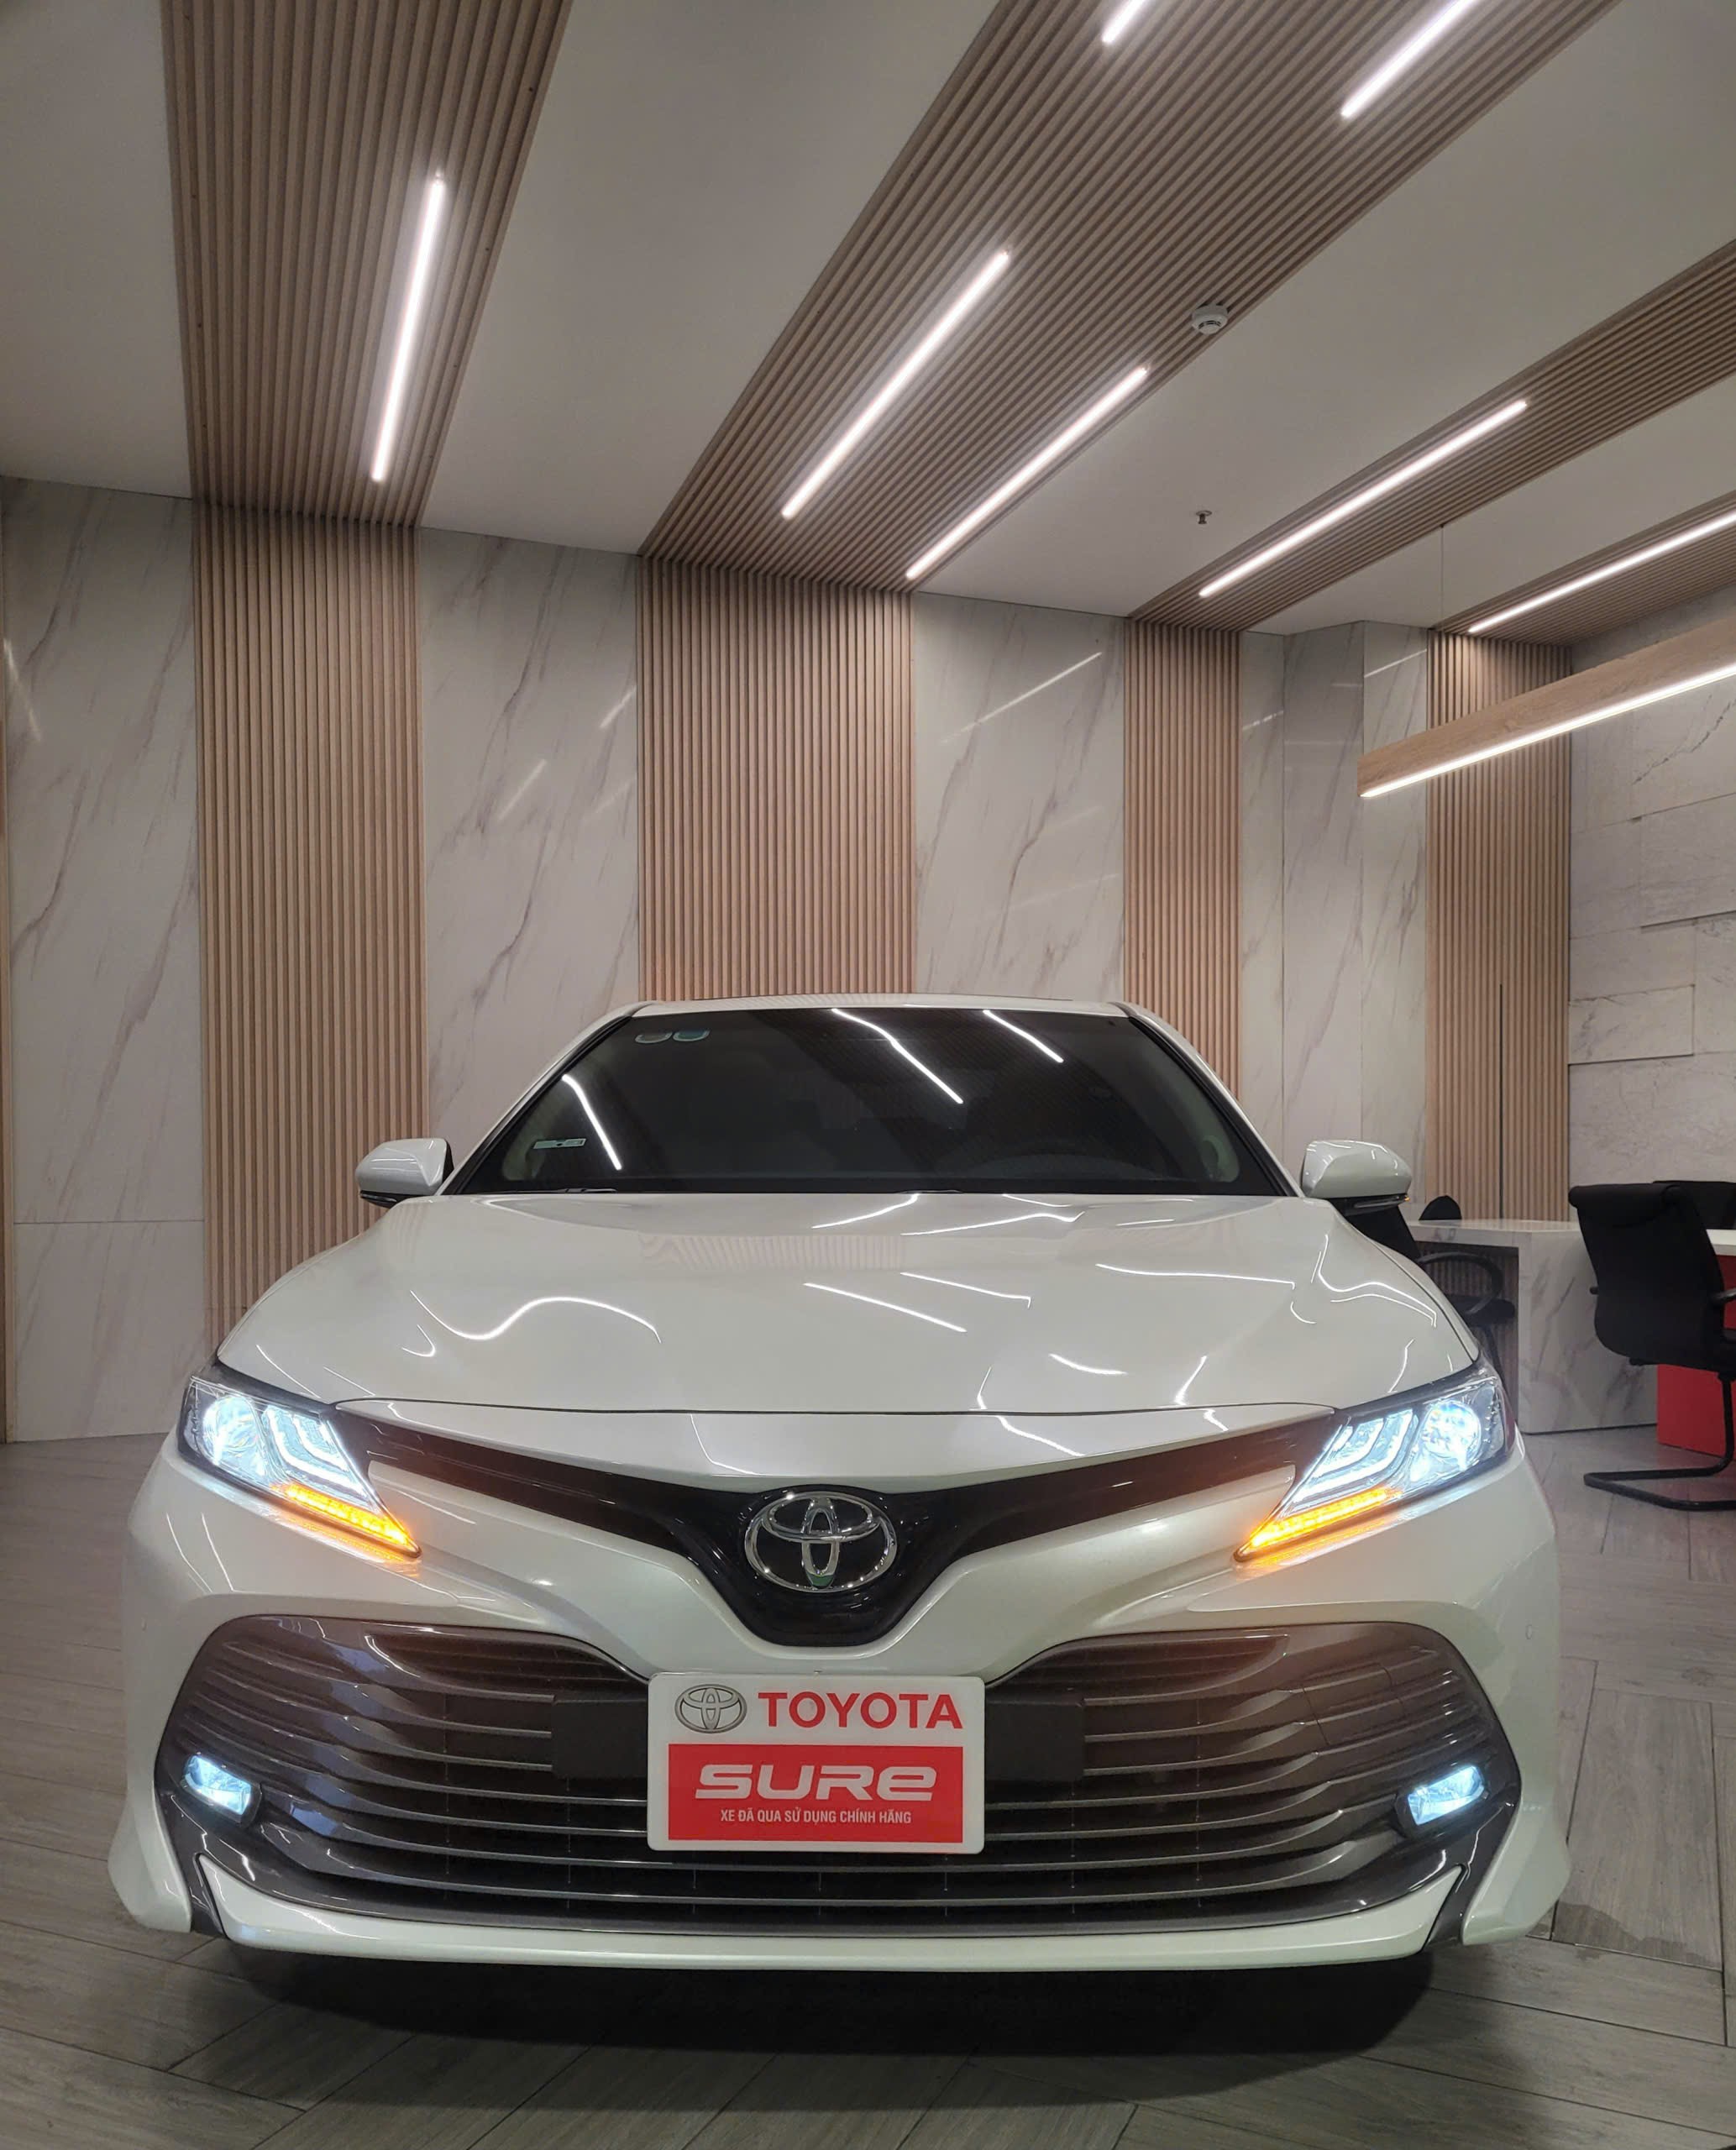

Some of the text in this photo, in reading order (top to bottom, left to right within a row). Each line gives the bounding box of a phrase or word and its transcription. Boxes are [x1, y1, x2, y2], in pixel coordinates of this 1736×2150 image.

[758, 1691, 963, 1729] TOYOTA
[721, 1809, 736, 1822] XE
[737, 1807, 754, 1822] ĐÃ
[757, 1809, 782, 1822] QUA
[784, 1807, 801, 1822] SỬ
[803, 1809, 837, 1826] DỤNG
[840, 1807, 876, 1823] CHÍNH
